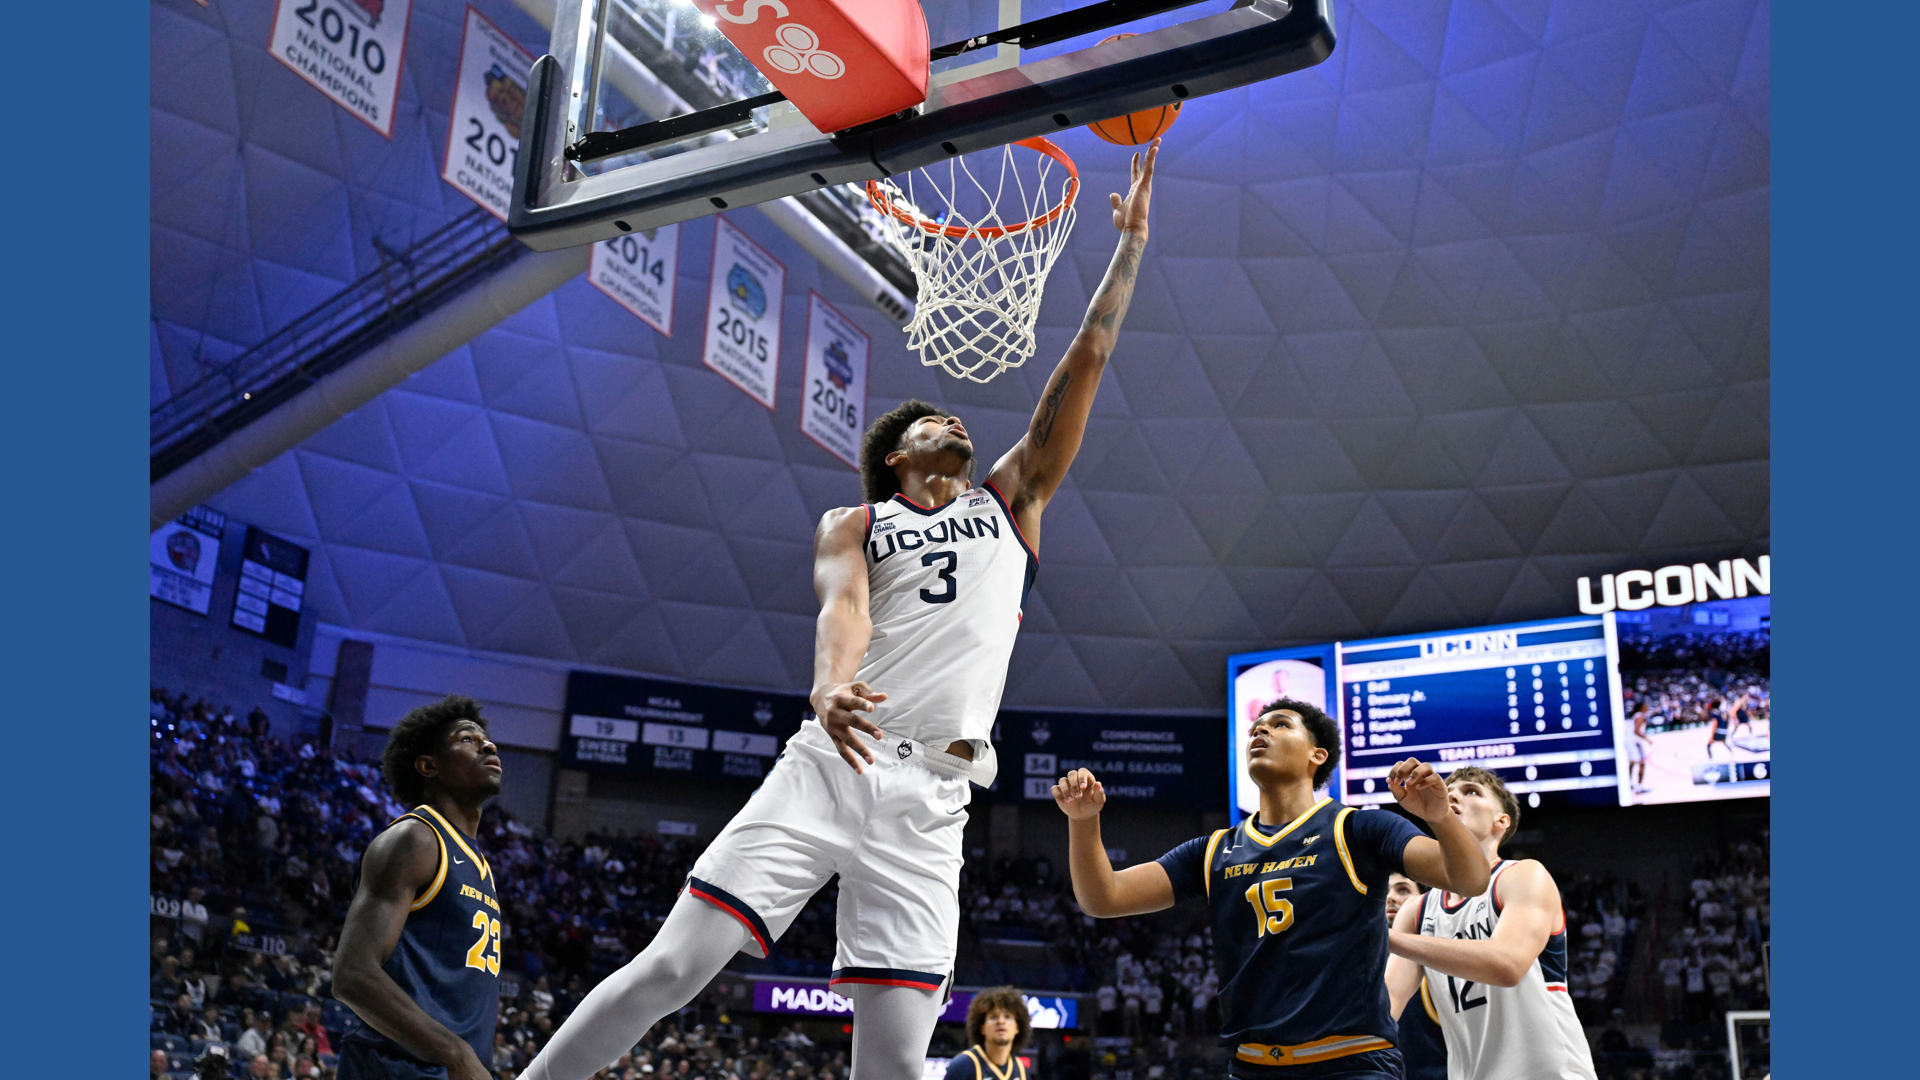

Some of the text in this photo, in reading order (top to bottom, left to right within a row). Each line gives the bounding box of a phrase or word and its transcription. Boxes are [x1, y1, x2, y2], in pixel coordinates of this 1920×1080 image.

[295, 0, 385, 75] 2010
[297, 28, 375, 97] NATIONAL
[286, 45, 379, 120] CHAMPIONS
[465, 117, 518, 178] 201
[465, 154, 512, 195] NATION
[717, 307, 768, 363] 2015
[812, 379, 857, 429] 2016
[870, 515, 999, 564] UCONN
[920, 551, 957, 604] 3
[1577, 555, 1770, 614] UCONN
[1420, 630, 1518, 659] UCONN
[596, 720, 614, 735] 19
[1439, 743, 1516, 761] TEAM STATS
[1128, 761, 1184, 775] SEASON
[1223, 854, 1318, 880] NEW HAVEN
[460, 884, 482, 902] NEW
[1245, 877, 1294, 938] 15
[465, 909, 501, 978] 23
[771, 986, 853, 1013] MADIS
